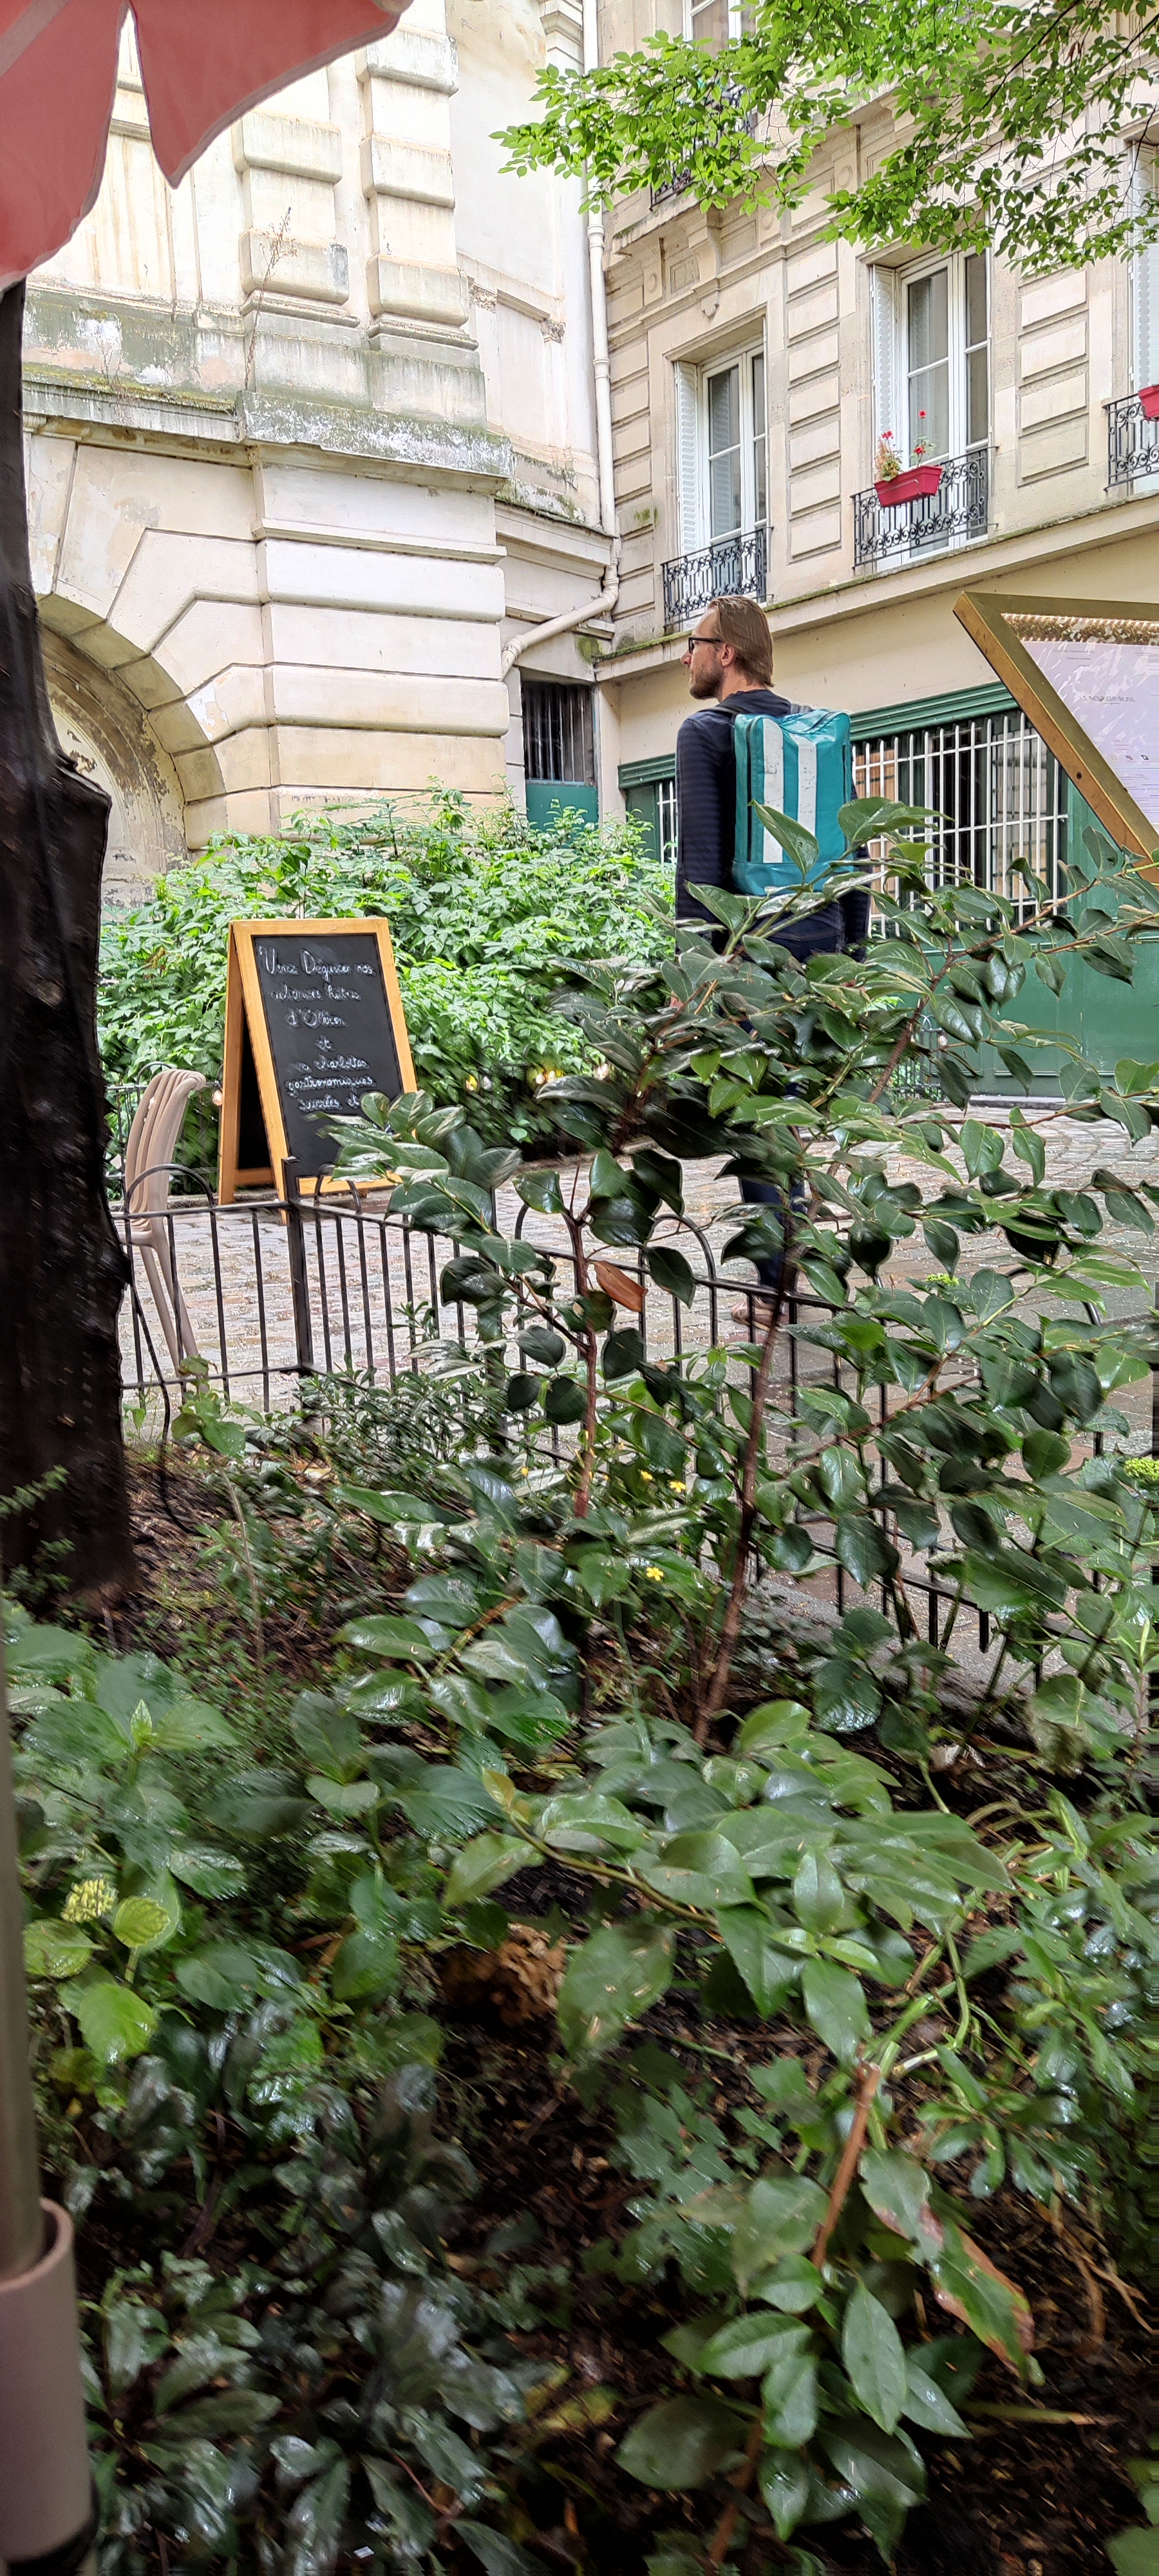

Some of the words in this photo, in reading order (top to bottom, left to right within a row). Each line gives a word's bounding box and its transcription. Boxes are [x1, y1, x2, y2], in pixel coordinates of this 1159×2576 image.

[357, 965, 375, 975] nos
[318, 1039, 332, 1050] et
[316, 1056, 368, 1070] charlottes
[288, 1075, 373, 1097] gastronomiques
[299, 1095, 340, 1110] sucrées
[347, 1094, 359, 1106] et
